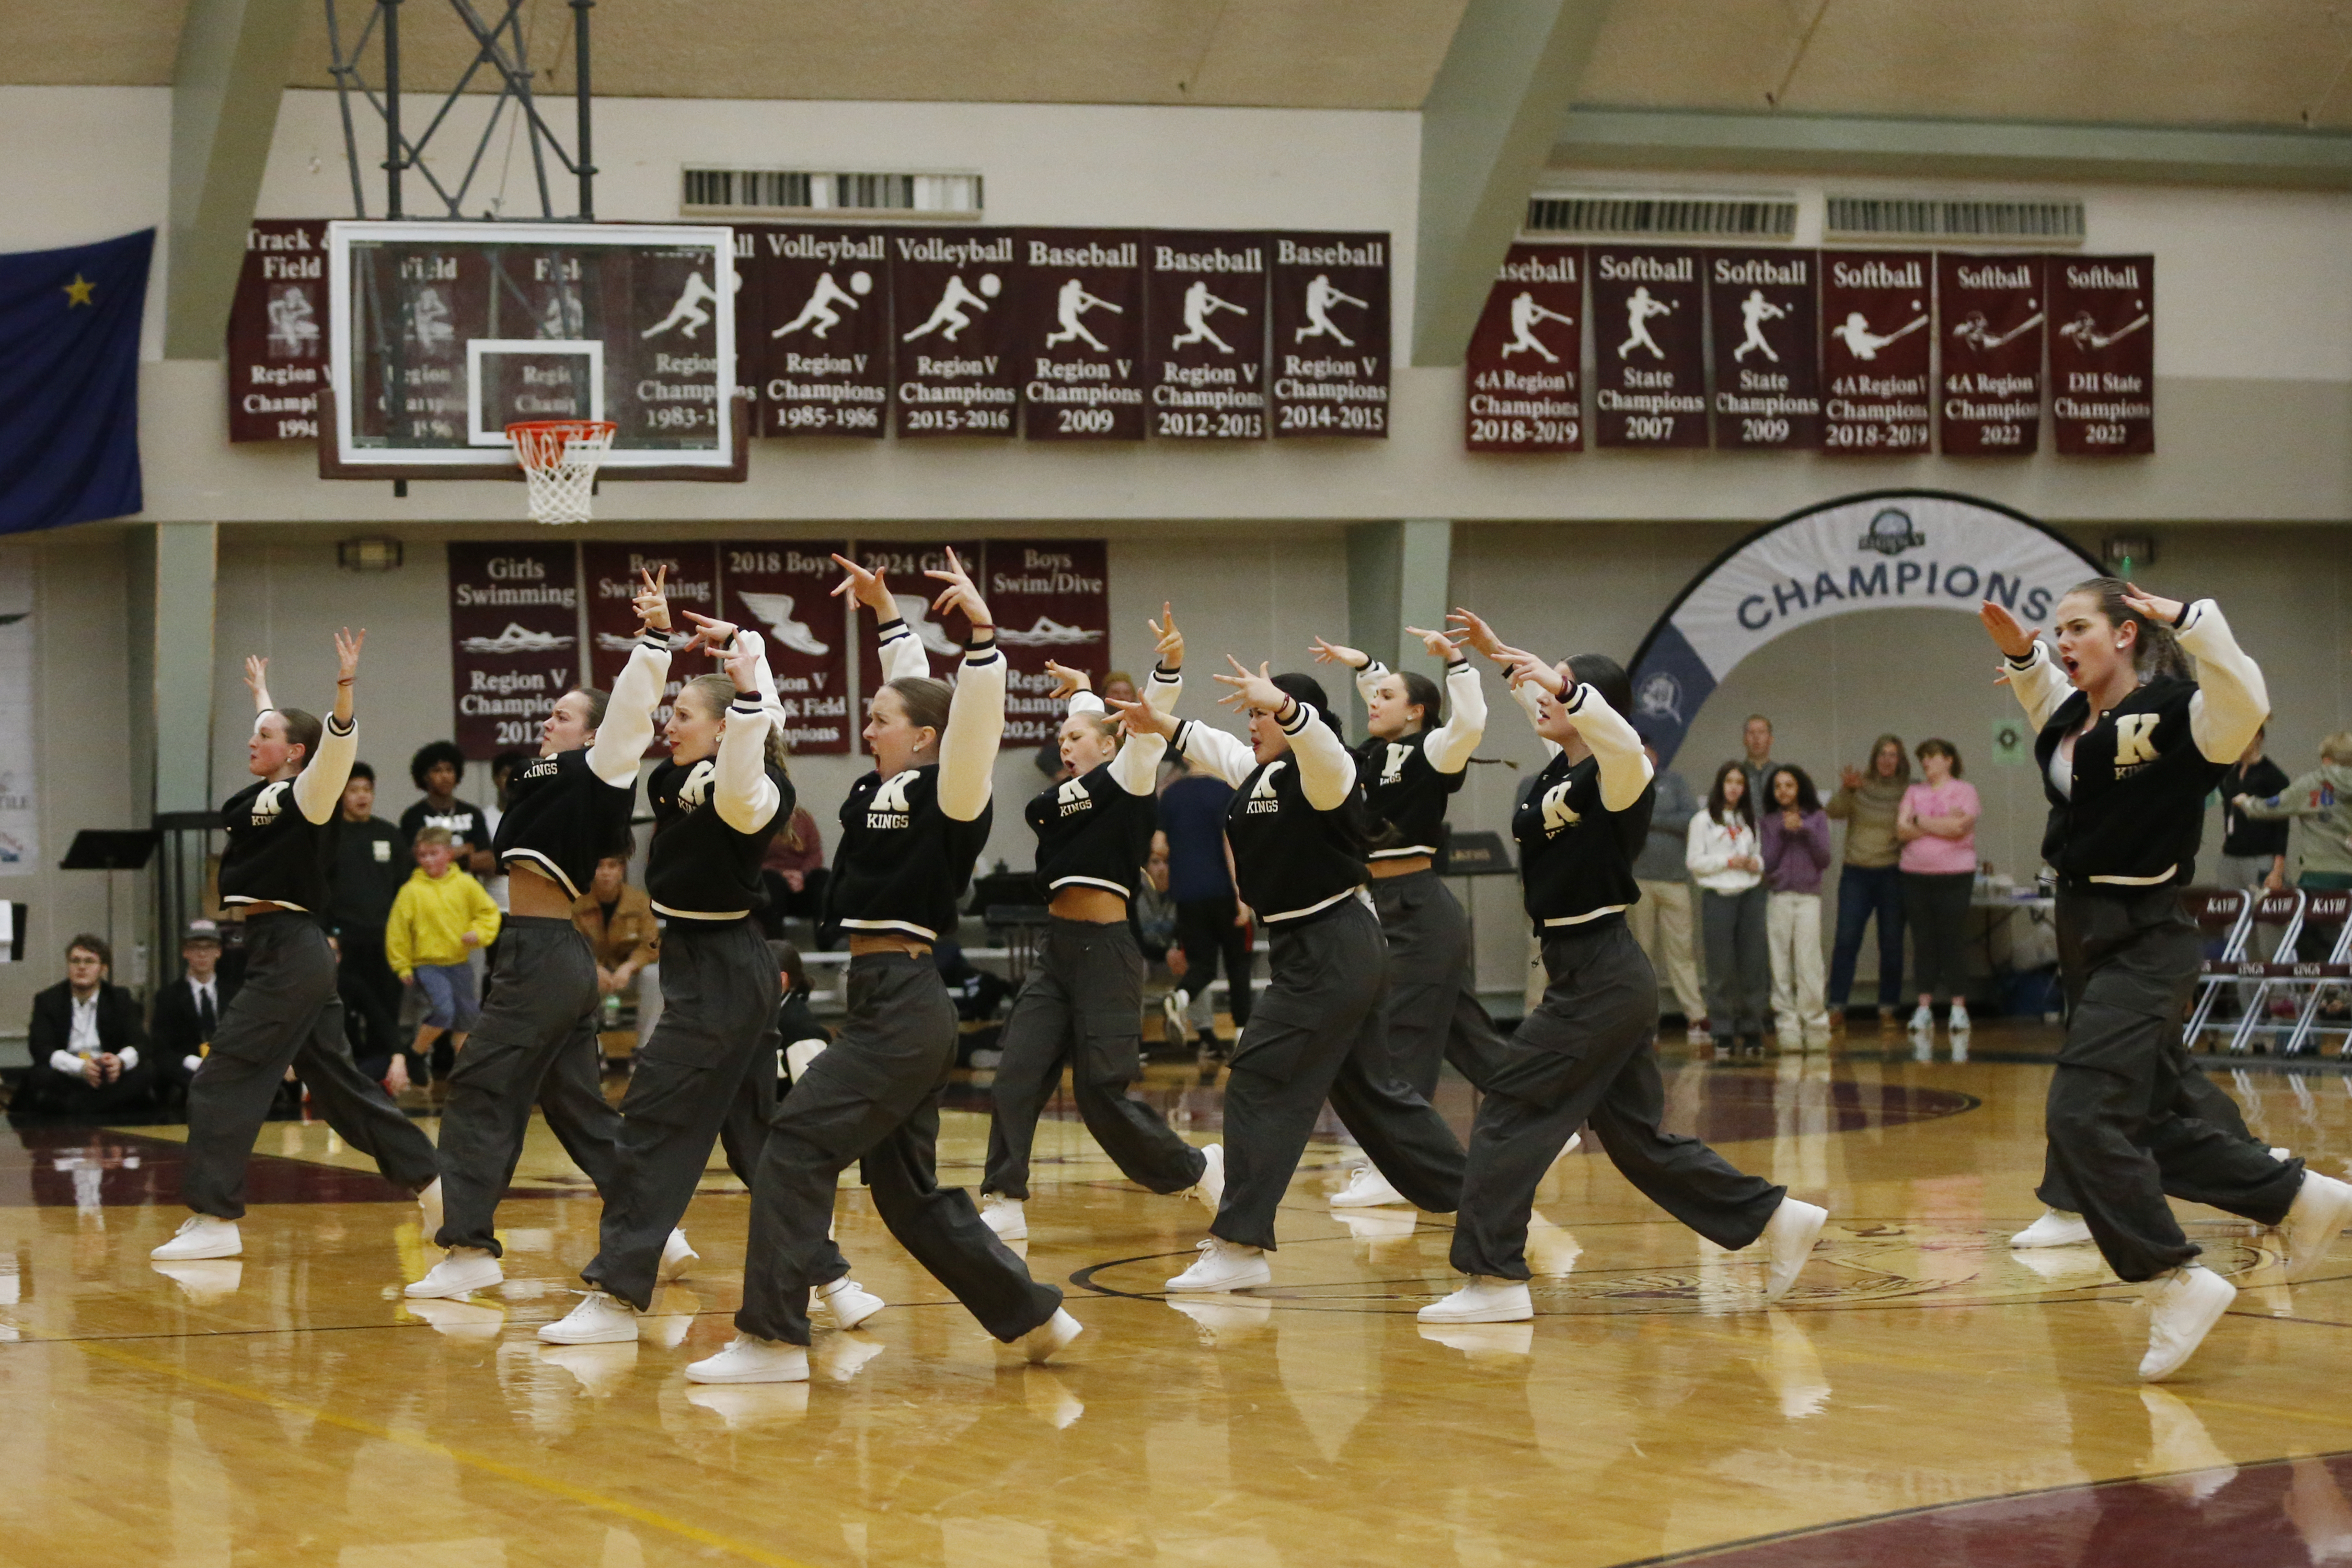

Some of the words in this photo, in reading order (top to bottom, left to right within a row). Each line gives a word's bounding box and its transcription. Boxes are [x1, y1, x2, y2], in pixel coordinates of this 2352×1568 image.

[767, 234, 885, 266] Volleyball
[896, 237, 1013, 269] Volleyball
[1028, 240, 1137, 268] Baseball
[1155, 246, 1263, 273] Baseball
[1278, 239, 1384, 267] Baseball
[263, 256, 321, 279] Field
[1599, 255, 1693, 282] Softball
[1715, 259, 1807, 285] Softball
[1833, 261, 1922, 289] Softball
[1957, 264, 2032, 289] Softball
[2066, 264, 2139, 290] Softball
[251, 364, 317, 387] Region
[786, 353, 852, 376] Region
[854, 354, 868, 373] V
[917, 355, 983, 378] Region
[985, 356, 998, 375] V
[1035, 358, 1111, 383] Region
[1116, 359, 1132, 379] V
[1163, 361, 1237, 388] Region
[1242, 363, 1258, 384] V
[1284, 355, 1357, 380] Region
[1364, 356, 1377, 377] V
[1623, 366, 1675, 388] State
[767, 379, 886, 405] Champions
[1274, 378, 1388, 403] Champions
[1474, 370, 1501, 391] 4A
[1504, 369, 1566, 396] Region
[1739, 369, 1789, 391] State
[1831, 374, 1857, 396] 4A
[1858, 374, 1918, 399] Region
[1945, 373, 1974, 394] 4A
[1977, 373, 2035, 398] Region
[2102, 372, 2143, 393] State
[243, 393, 318, 415] Champi
[898, 382, 1016, 406] Champions
[1026, 381, 1143, 405] Champions
[1597, 389, 1705, 414] Champions
[1715, 391, 1819, 417] Champions
[777, 406, 879, 428] 1985-1986
[907, 410, 1010, 430] 2015-2016
[1058, 409, 1114, 433] 2009
[1158, 412, 1262, 437] 2012-2013
[1279, 405, 1385, 431] 2014-2015
[1625, 416, 1675, 440] 2007
[1470, 419, 1579, 444] 2018-2019
[1742, 419, 1790, 442] 2009
[1826, 424, 1929, 447] 2018-2019
[487, 557, 545, 580] Girls
[729, 552, 782, 573] 2018
[787, 552, 837, 579] Boys
[1024, 549, 1073, 573] Boys
[456, 583, 576, 610] Swimming
[994, 573, 1103, 595] Swim/Dive
[1737, 561, 2053, 631] CHAMPIONS
[470, 669, 546, 696] Region
[550, 667, 568, 689] V
[811, 672, 828, 691] V
[459, 693, 559, 719] Champio
[802, 696, 847, 718] Field
[2114, 713, 2161, 765] K
[1059, 799, 1093, 817] KINGS
[1246, 800, 1279, 814] KINGS
[866, 813, 909, 829] KINGS
